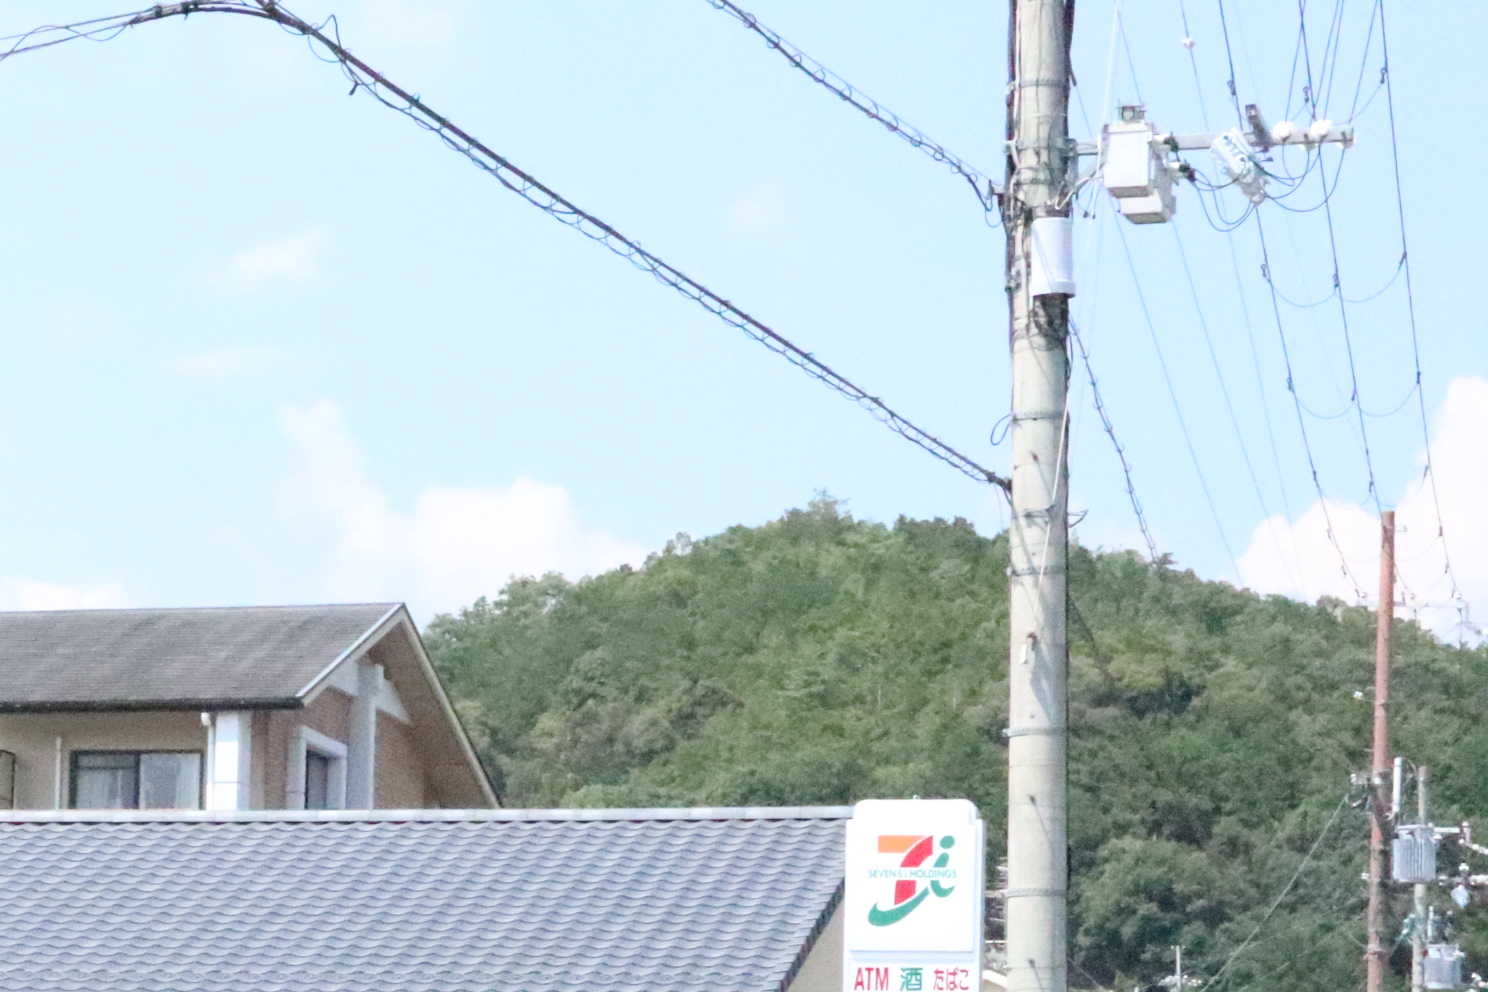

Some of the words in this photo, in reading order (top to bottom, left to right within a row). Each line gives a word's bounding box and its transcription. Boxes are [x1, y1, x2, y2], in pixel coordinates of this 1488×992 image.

[909, 869, 957, 878] HOLDINGS
[854, 967, 889, 991] ATM
[900, 967, 923, 991] 酒
[933, 967, 970, 991] たばこ
